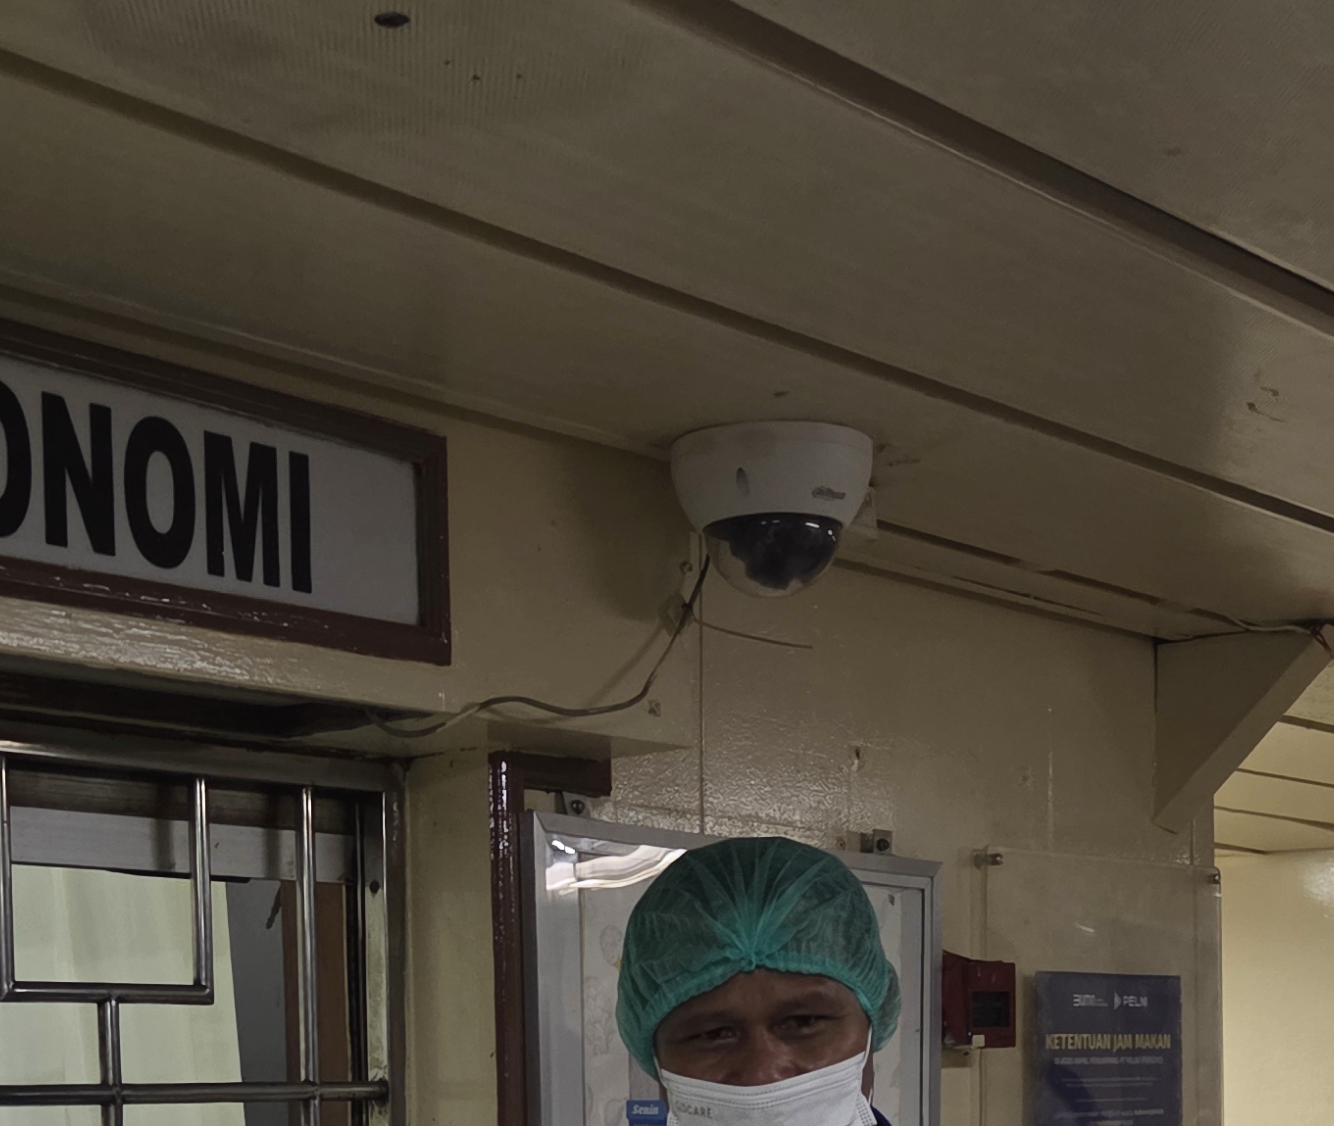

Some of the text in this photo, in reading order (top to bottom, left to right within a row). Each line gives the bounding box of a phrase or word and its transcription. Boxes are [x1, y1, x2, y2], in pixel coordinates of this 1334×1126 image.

[1045, 1033, 1171, 1053] KETENTUAN JAM MAKAN
